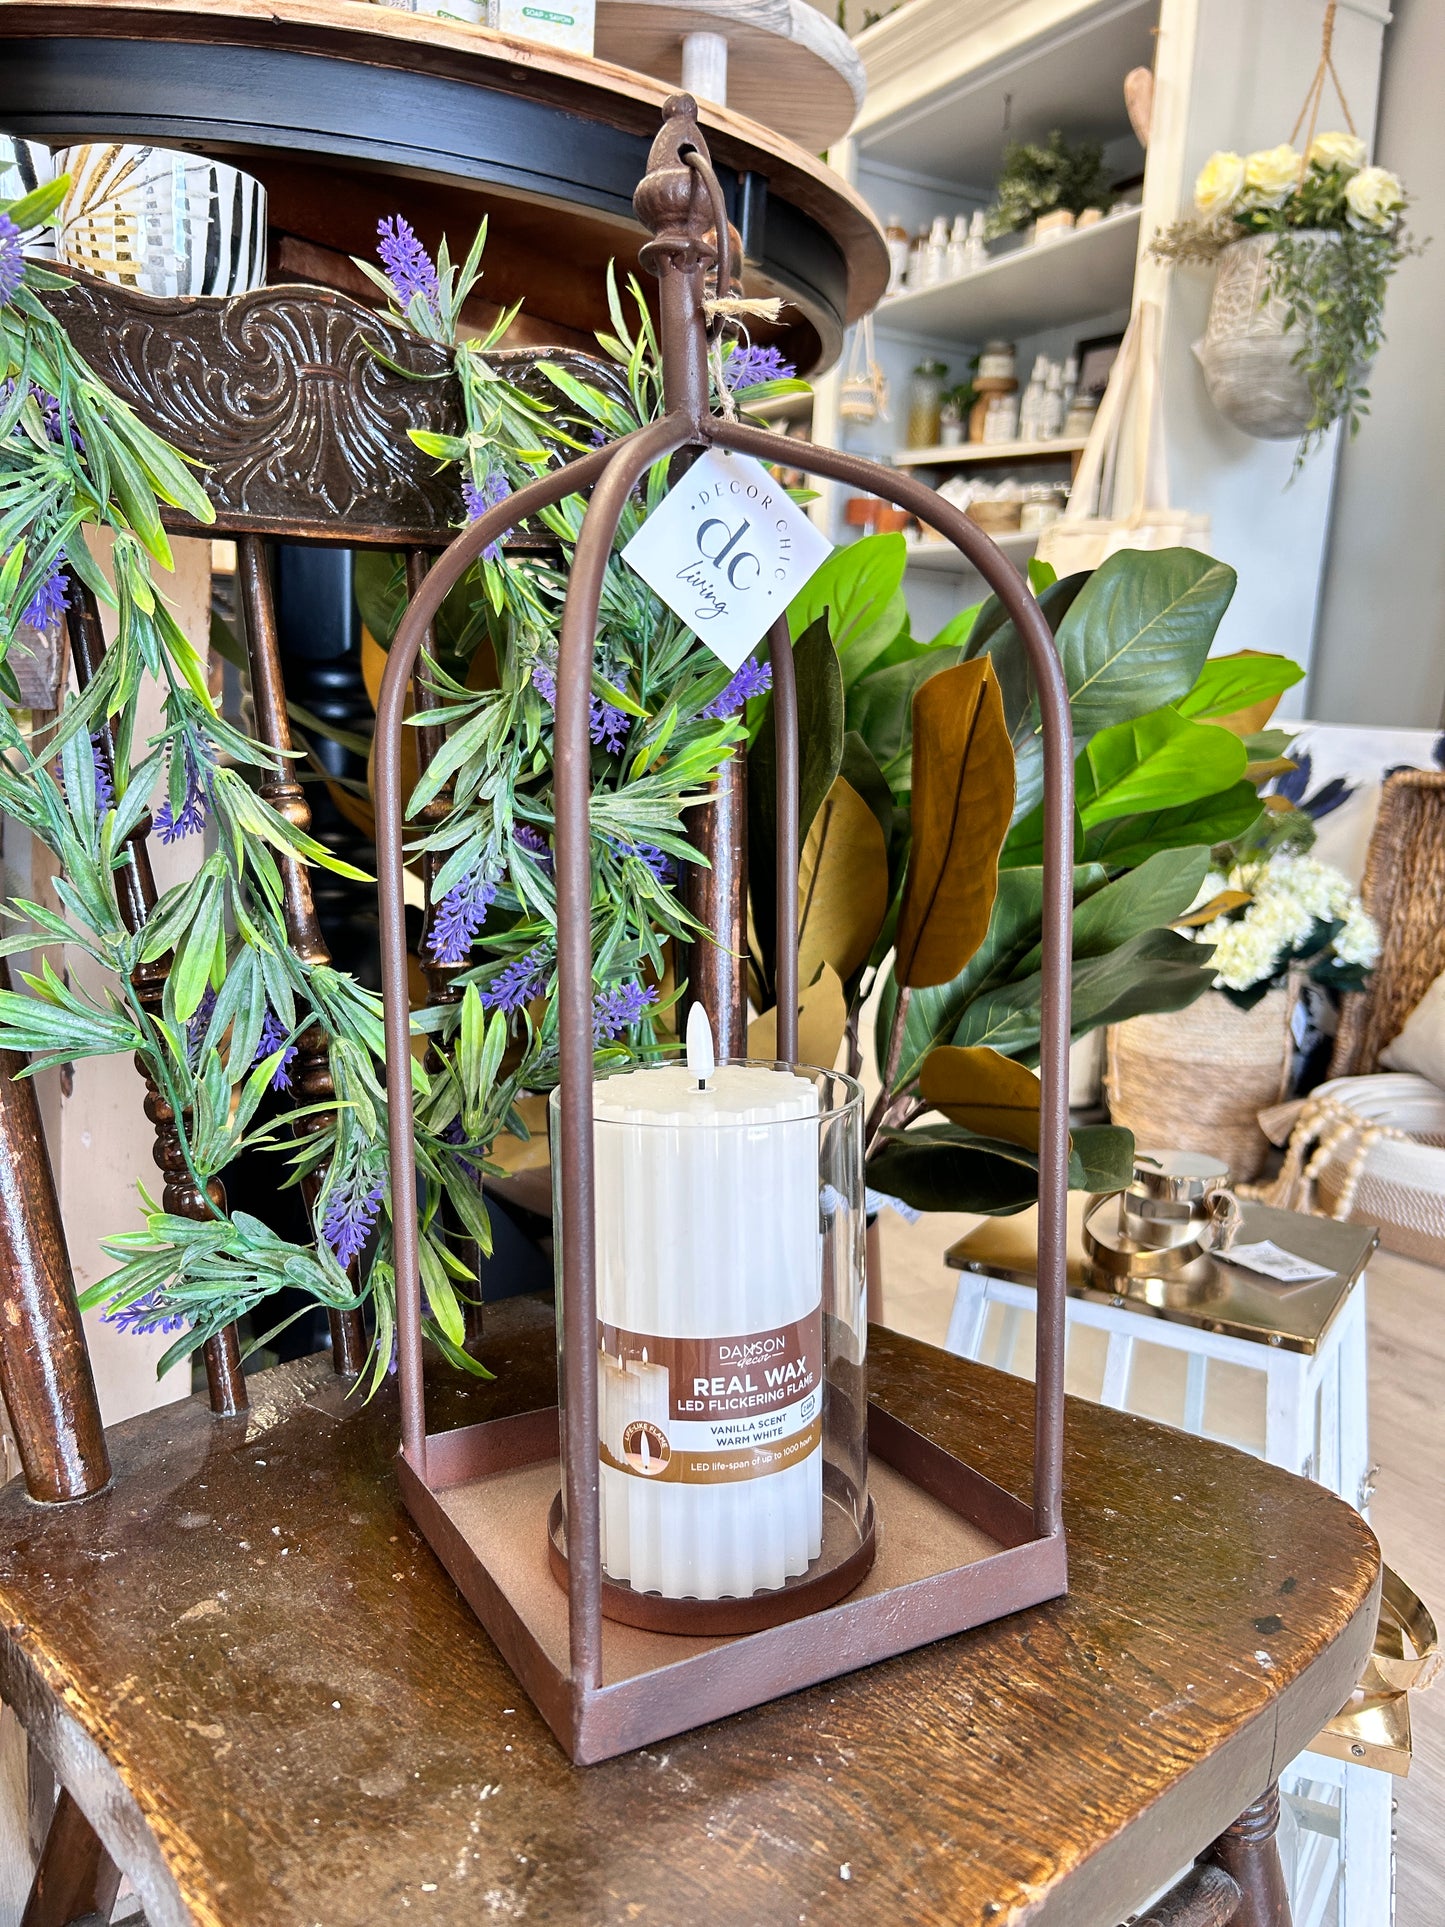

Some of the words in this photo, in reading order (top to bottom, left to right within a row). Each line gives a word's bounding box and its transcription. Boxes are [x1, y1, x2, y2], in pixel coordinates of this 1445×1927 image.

[698, 480, 773, 510] DECOR
[774, 519, 791, 581] CHIC
[696, 517, 761, 591] dc
[676, 560, 729, 620] living
[719, 1335, 785, 1360] DANSON
[737, 1344, 771, 1368] decor
[677, 1399, 705, 1411] LED
[708, 1389, 785, 1412] FLICKERING
[786, 1372, 813, 1396] FLAME
[693, 1374, 758, 1396] REAL
[764, 1356, 806, 1387] WAX
[624, 1422, 648, 1441] LIFE-LIKE
[649, 1425, 668, 1448] FLAME
[710, 1422, 755, 1435] VANILLA
[758, 1413, 787, 1429] SCENT
[716, 1434, 750, 1446] WARM
[752, 1427, 783, 1441] WHITE
[691, 1463, 709, 1471] LED
[712, 1459, 749, 1471] life-span
[751, 1456, 761, 1466] of
[761, 1454, 773, 1464] up
[774, 1450, 782, 1459] to
[783, 1443, 799, 1456] 1000
[799, 1435, 813, 1448] hours
